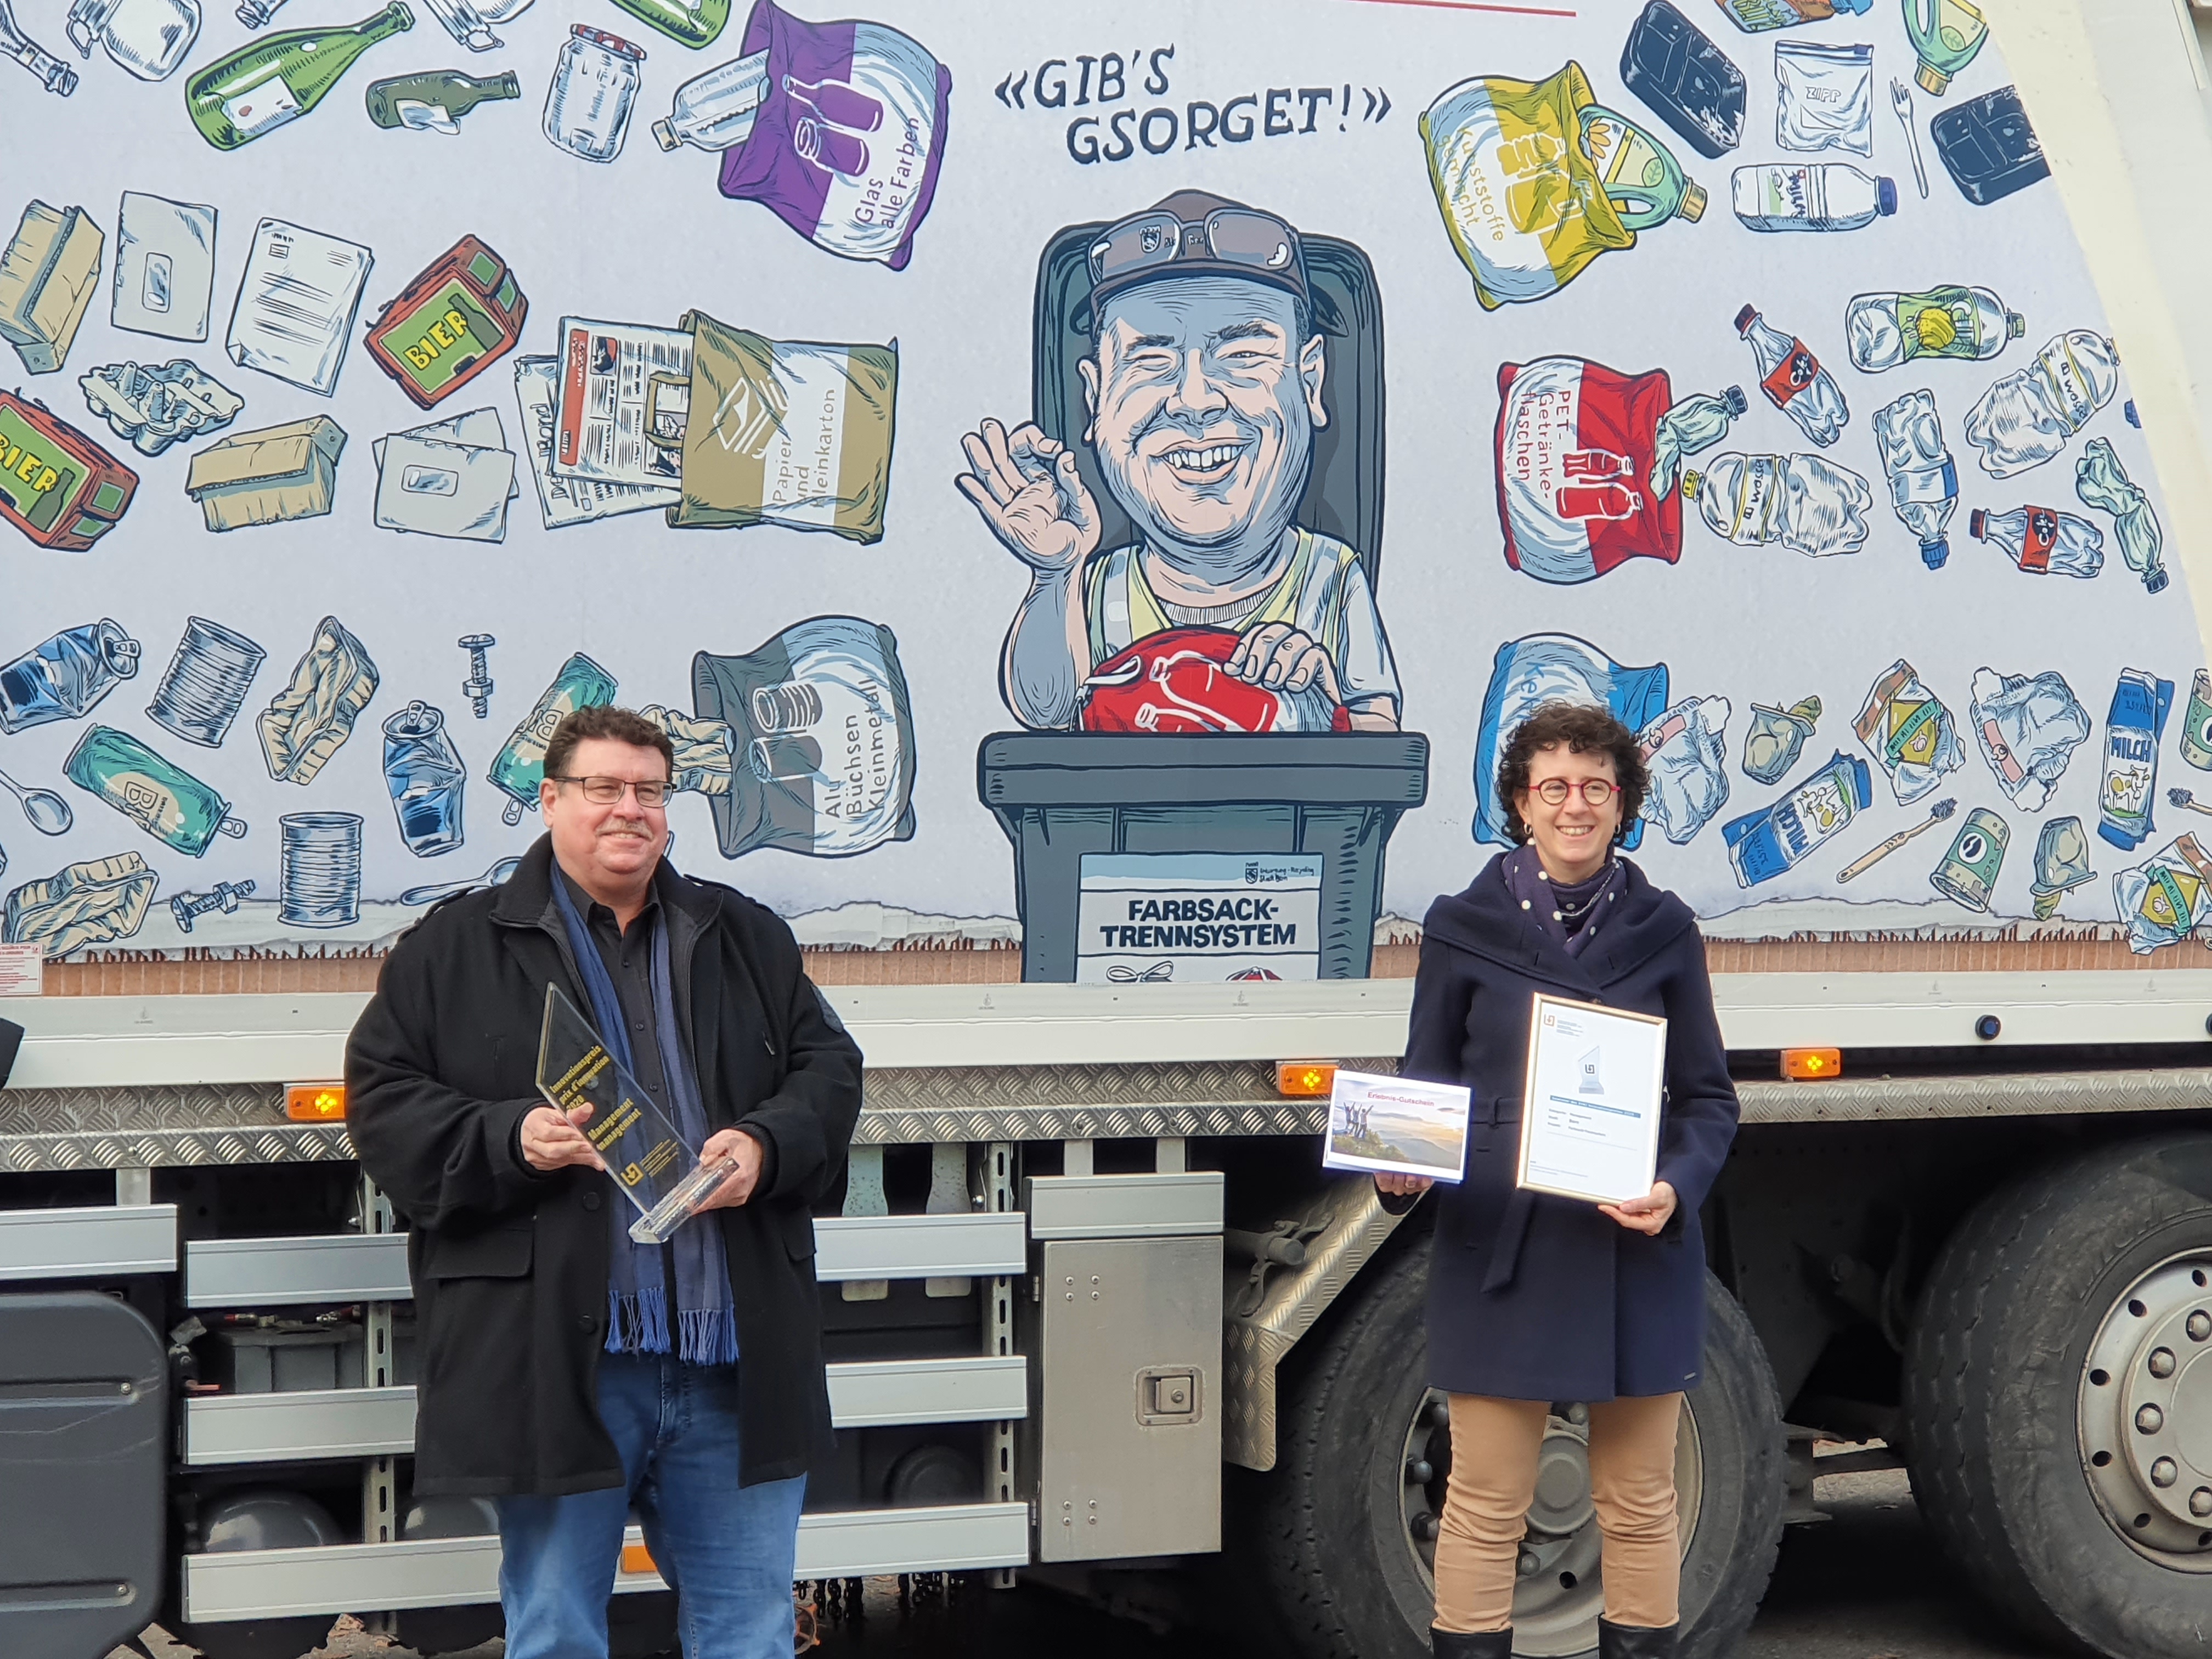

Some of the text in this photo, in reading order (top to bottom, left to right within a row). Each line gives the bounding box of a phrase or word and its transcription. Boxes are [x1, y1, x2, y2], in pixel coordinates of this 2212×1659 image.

[1805, 86, 1842, 103] ZIPP
[879, 117, 919, 229] alle Farben
[854, 178, 884, 224] Glas
[402, 309, 469, 371] BIER
[1516, 391, 1537, 481] flaschen
[1556, 390, 1571, 440] PET-
[1537, 392, 1554, 499] Getränke-
[772, 438, 794, 503] Papier
[843, 714, 864, 816] Büchsen
[857, 678, 887, 811] Kleinmetall
[2111, 736, 2152, 763] MILCH
[824, 780, 842, 819] Alu
[1775, 802, 1810, 857] MILCH
[1128, 898, 1279, 922] FARBSACK-
[1099, 923, 1296, 949] TRENNSYSTEM
[549, 1045, 602, 1094] Innovationspreis
[558, 1089, 574, 1105] prix
[588, 1097, 634, 1141] Management
[1367, 1090, 1435, 1107] Erlebnis-Gutschein
[596, 1108, 642, 1152] management
